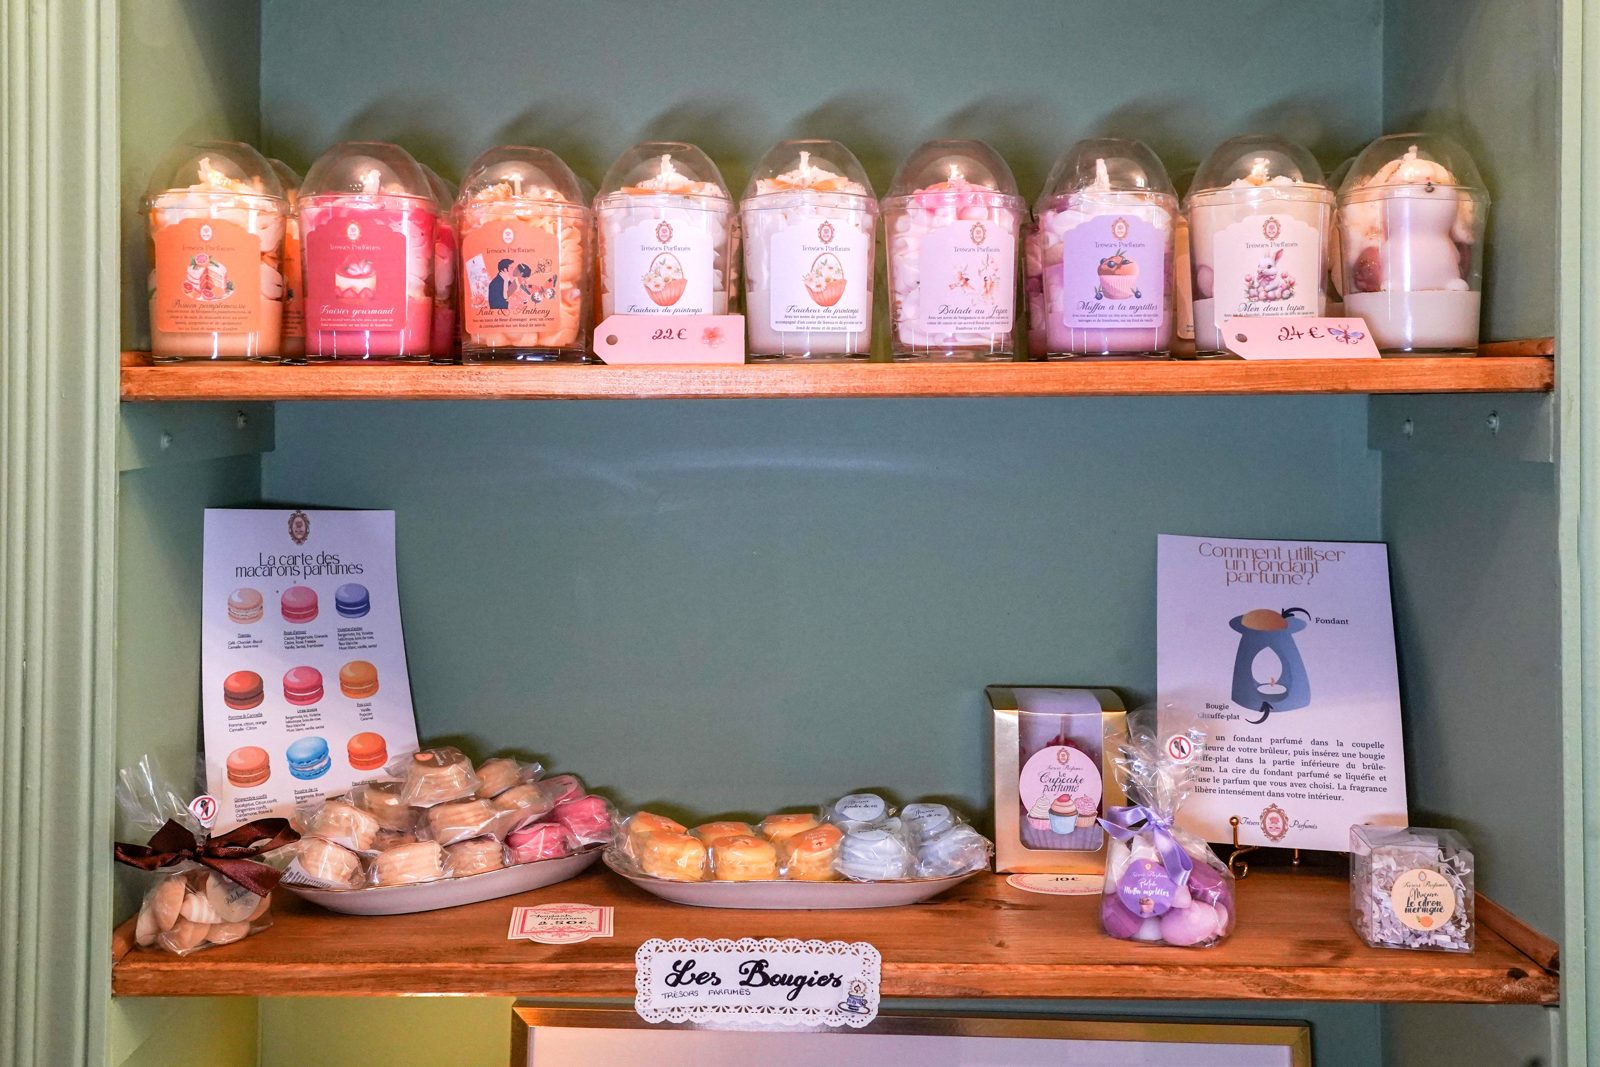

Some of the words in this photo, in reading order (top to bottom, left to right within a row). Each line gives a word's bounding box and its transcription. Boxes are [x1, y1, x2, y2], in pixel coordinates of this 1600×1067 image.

[513, 306, 551, 318] Anthony
[652, 328, 674, 340] 22
[1278, 326, 1304, 341] 24
[259, 552, 276, 566] La
[279, 552, 313, 565] carte
[316, 551, 340, 564] des
[1198, 542, 1281, 561] Comment
[1288, 547, 1346, 562] utiliser
[235, 564, 300, 577] macarons
[1225, 560, 1246, 571] un
[1252, 558, 1319, 574] fondant
[1315, 617, 1349, 625] Fondant
[1205, 703, 1230, 711] Bougie
[1233, 734, 1262, 743] fondant
[1270, 736, 1303, 746] parfumé
[1336, 739, 1344, 747] la
[1352, 741, 1385, 750] coupelle
[1260, 746, 1291, 756] brûleur,
[1293, 748, 1309, 758] puis
[1311, 748, 1340, 758] insérez
[1341, 751, 1357, 759] une
[1358, 751, 1386, 761] bougie
[1235, 756, 1254, 764] dans
[1272, 758, 1295, 768] partie
[1301, 759, 1340, 768] inférieure
[1345, 761, 1356, 769] du
[1362, 762, 1386, 771] brûle-
[1038, 771, 1085, 788] Cupcake
[1250, 767, 1260, 775] du
[1263, 768, 1293, 777] fondant
[1297, 770, 1330, 780] parfumé
[1345, 772, 1376, 783] liquéfie
[1379, 774, 1387, 782] et
[1213, 776, 1220, 784] le
[1222, 776, 1250, 787] parfum
[1253, 780, 1267, 788] que
[1269, 780, 1287, 788] vous
[1309, 780, 1335, 790] choisi.
[1337, 782, 1347, 790] La
[1349, 783, 1388, 794] fragrance
[1194, 785, 1217, 795] libère
[1218, 786, 1265, 797] intensément
[1267, 790, 1285, 798] dans
[1286, 791, 1306, 799] votre
[1308, 791, 1345, 801] intérieur.
[665, 959, 722, 987] Les
[738, 958, 843, 1002] Bougies
[661, 989, 699, 1000] TRÉSORS
[708, 988, 751, 997] PARFUMÉS
